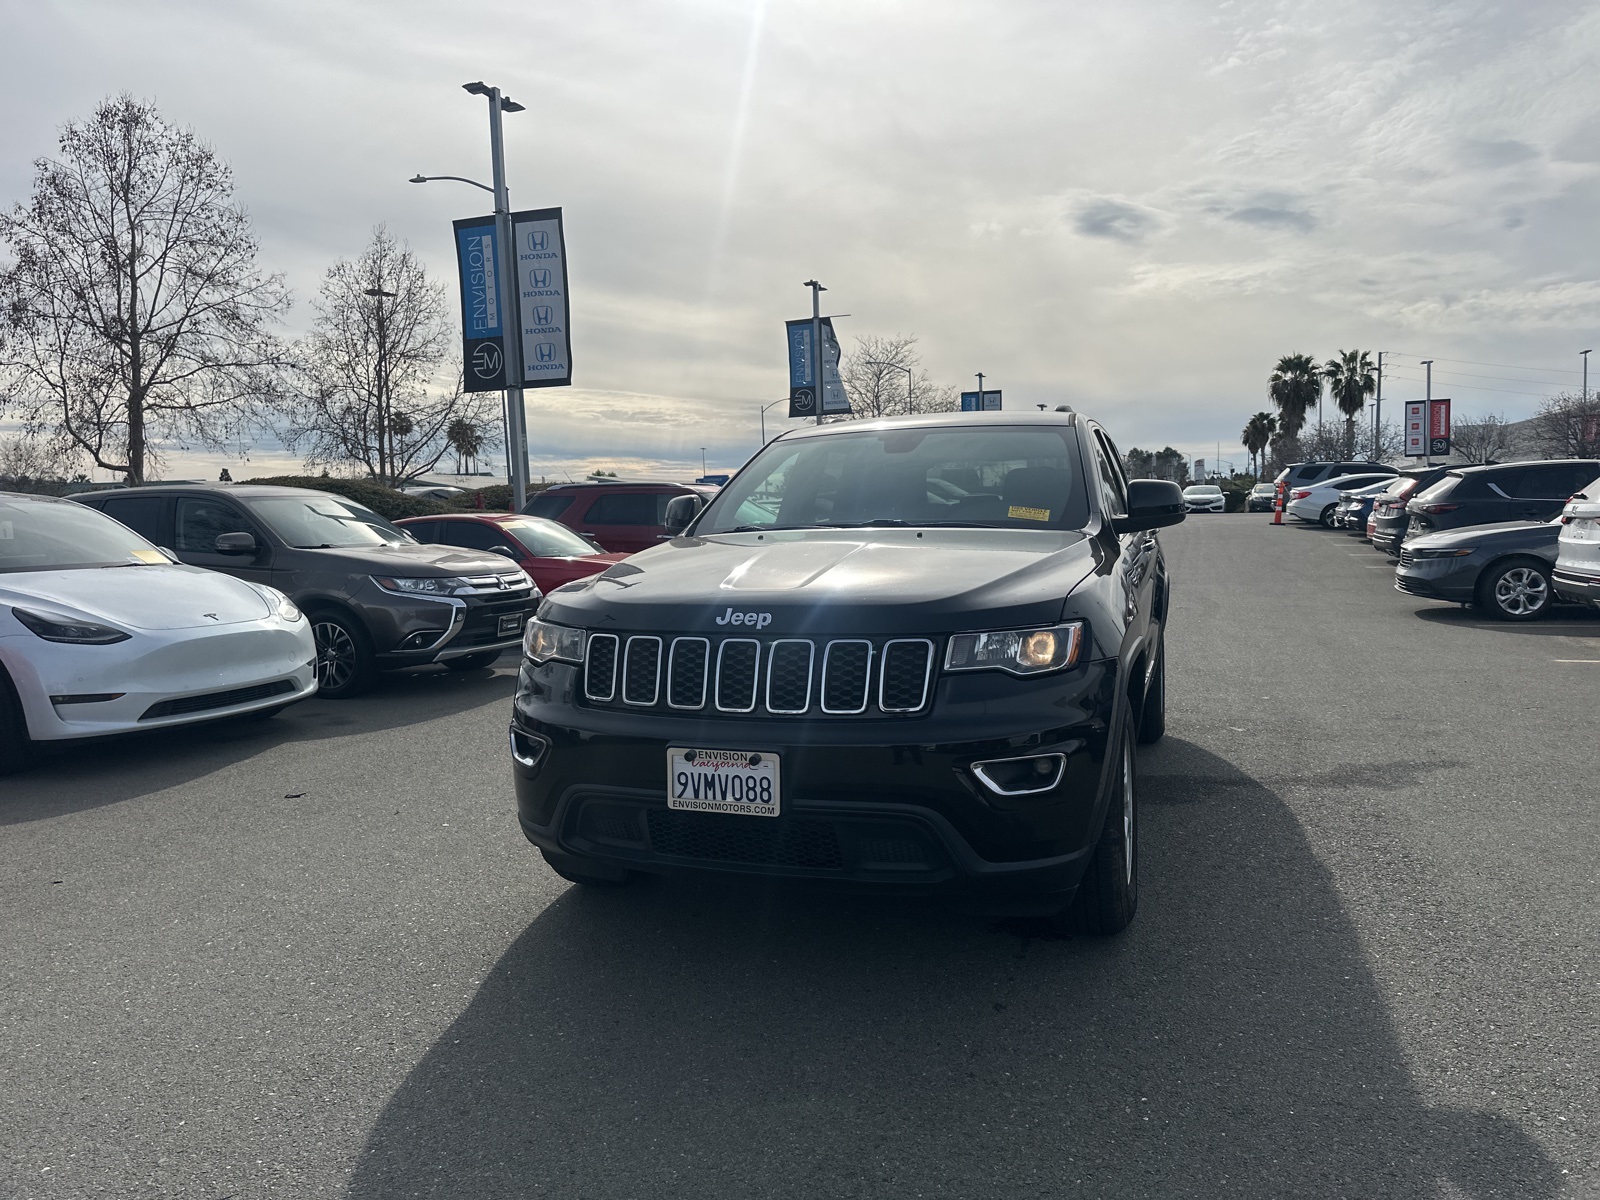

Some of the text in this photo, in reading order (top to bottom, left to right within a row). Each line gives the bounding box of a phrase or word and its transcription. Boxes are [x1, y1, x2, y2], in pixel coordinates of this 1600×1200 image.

[520, 252, 558, 260] HONDA
[468, 236, 488, 330] ENVISION
[484, 244, 496, 320] MOTORS
[523, 289, 561, 298] HONDA
[525, 326, 562, 334] HONDA
[794, 330, 805, 382] ENVISION
[716, 608, 772, 629] Jeep
[698, 750, 748, 761] ENVISION
[692, 760, 752, 772] California
[677, 772, 772, 803] 9VMV088
[672, 800, 775, 815] ENVISIONMOTORS.COM
